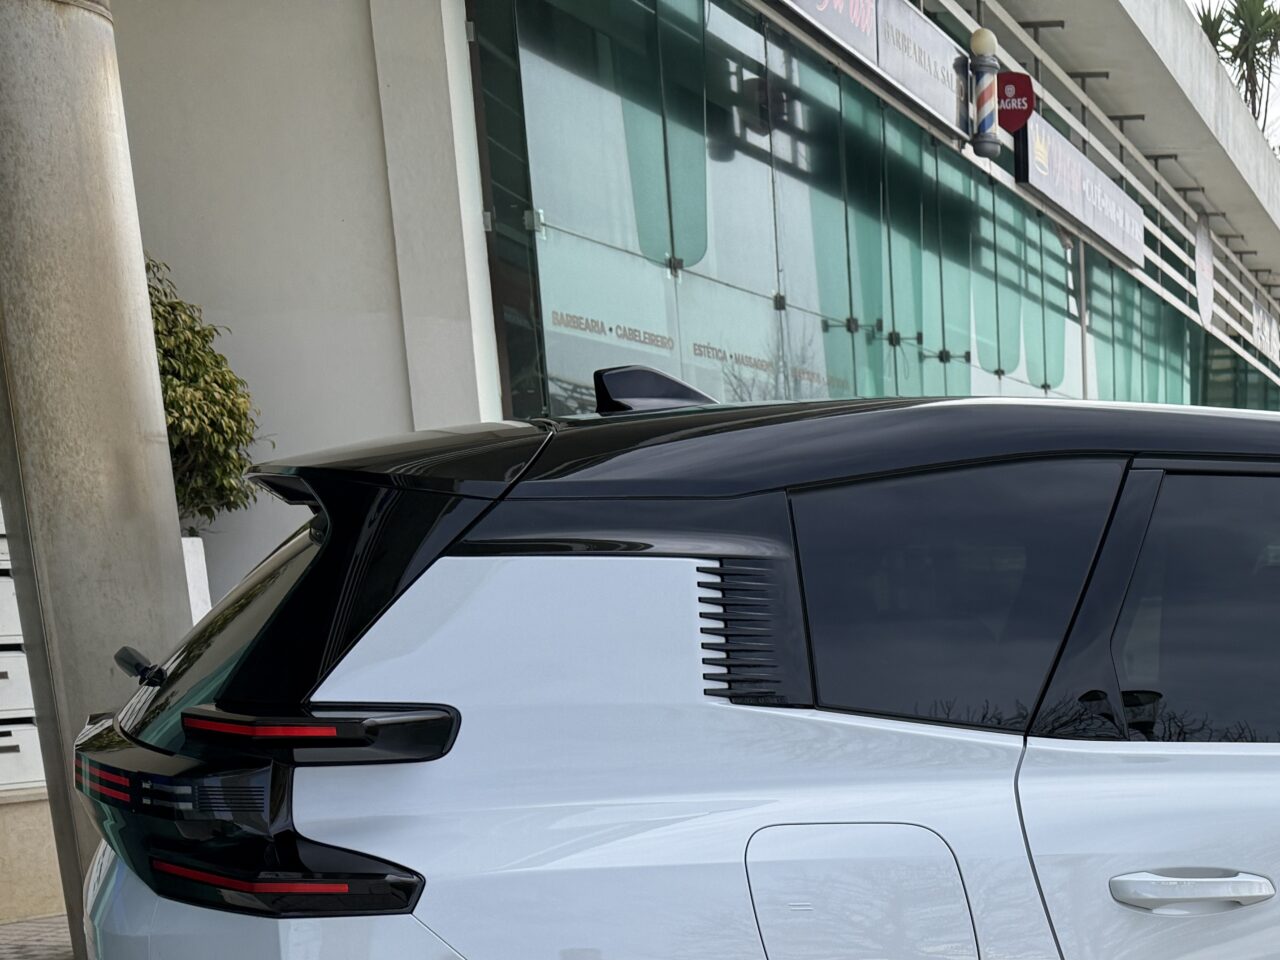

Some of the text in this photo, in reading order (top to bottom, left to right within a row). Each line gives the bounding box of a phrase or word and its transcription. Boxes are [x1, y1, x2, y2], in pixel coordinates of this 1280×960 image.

[884, 20, 932, 75] BARBEARIA
[552, 310, 674, 350] BARBEARIA CABELEIREIRO
[693, 342, 727, 362] ESTÉTICA
